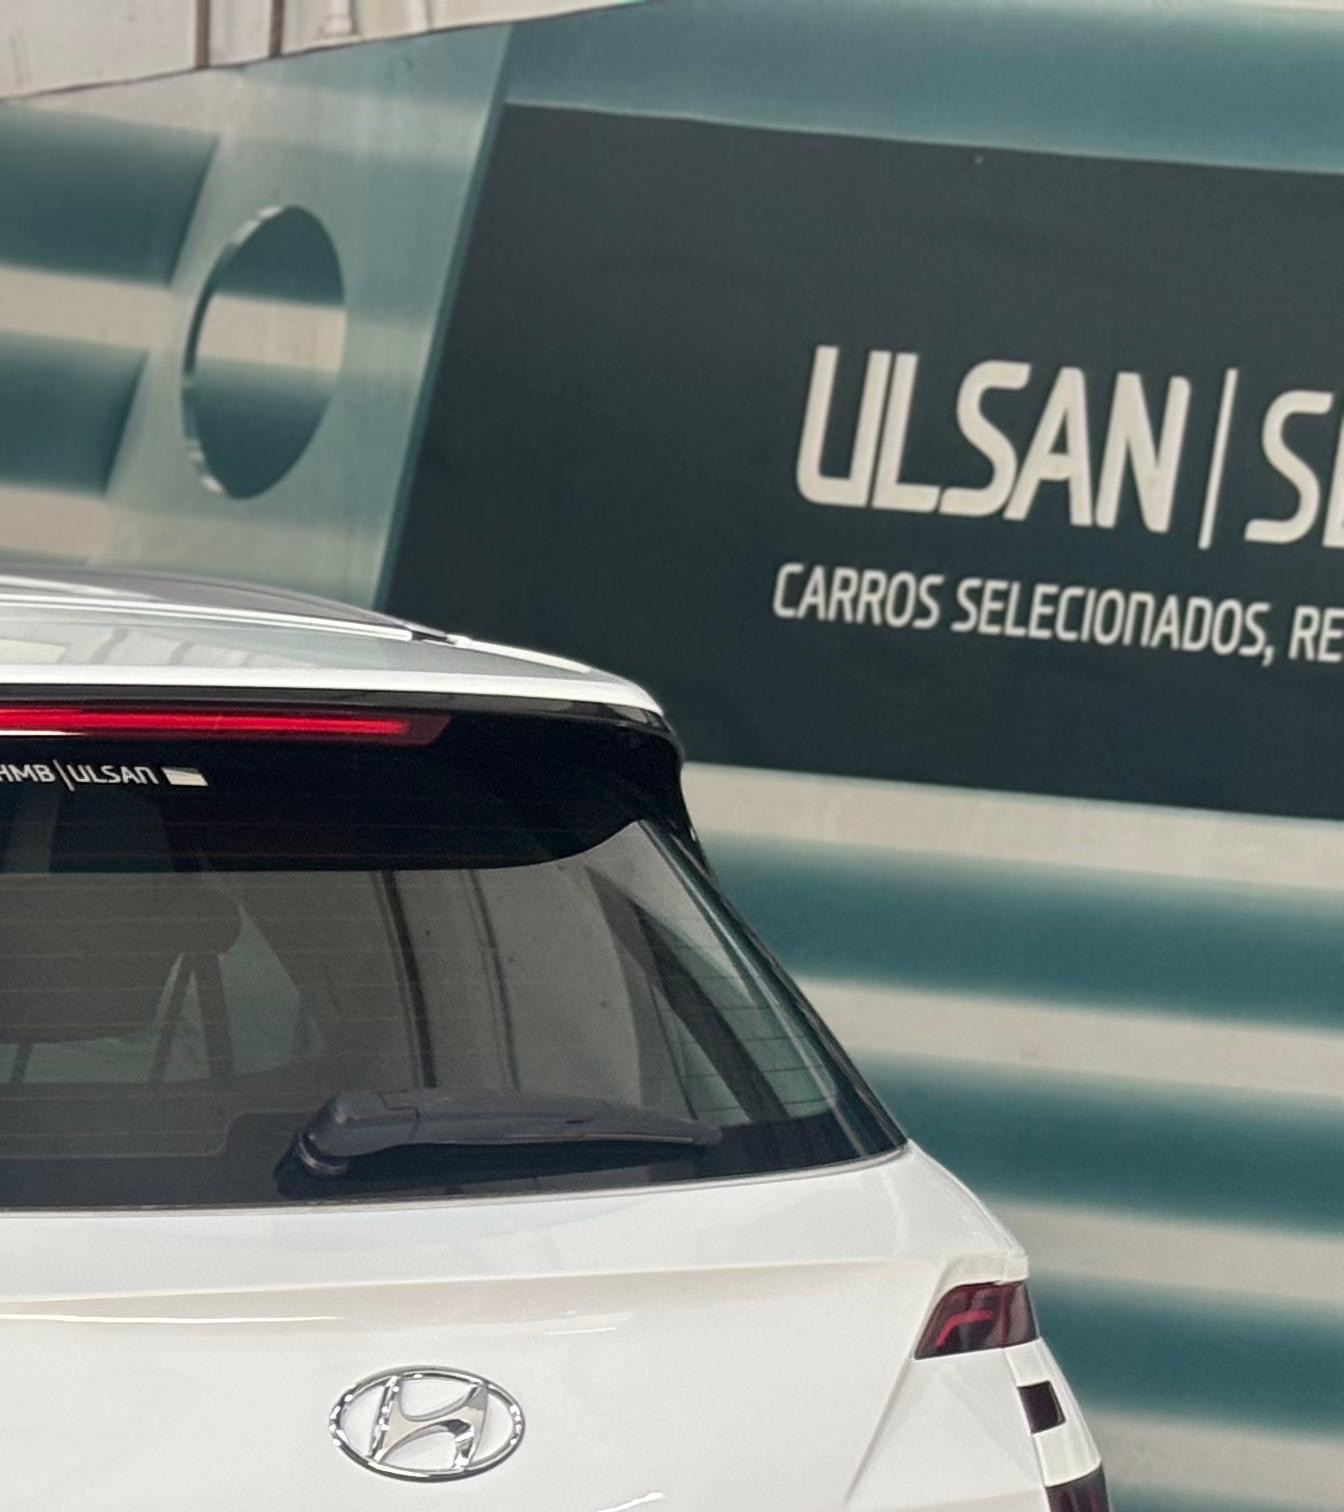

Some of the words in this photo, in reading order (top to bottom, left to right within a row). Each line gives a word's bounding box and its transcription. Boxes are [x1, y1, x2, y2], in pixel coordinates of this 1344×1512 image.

[796, 345, 1191, 534] ULSAN
[772, 563, 944, 629] CARROS
[950, 577, 1275, 666] SELECIONADOS,
